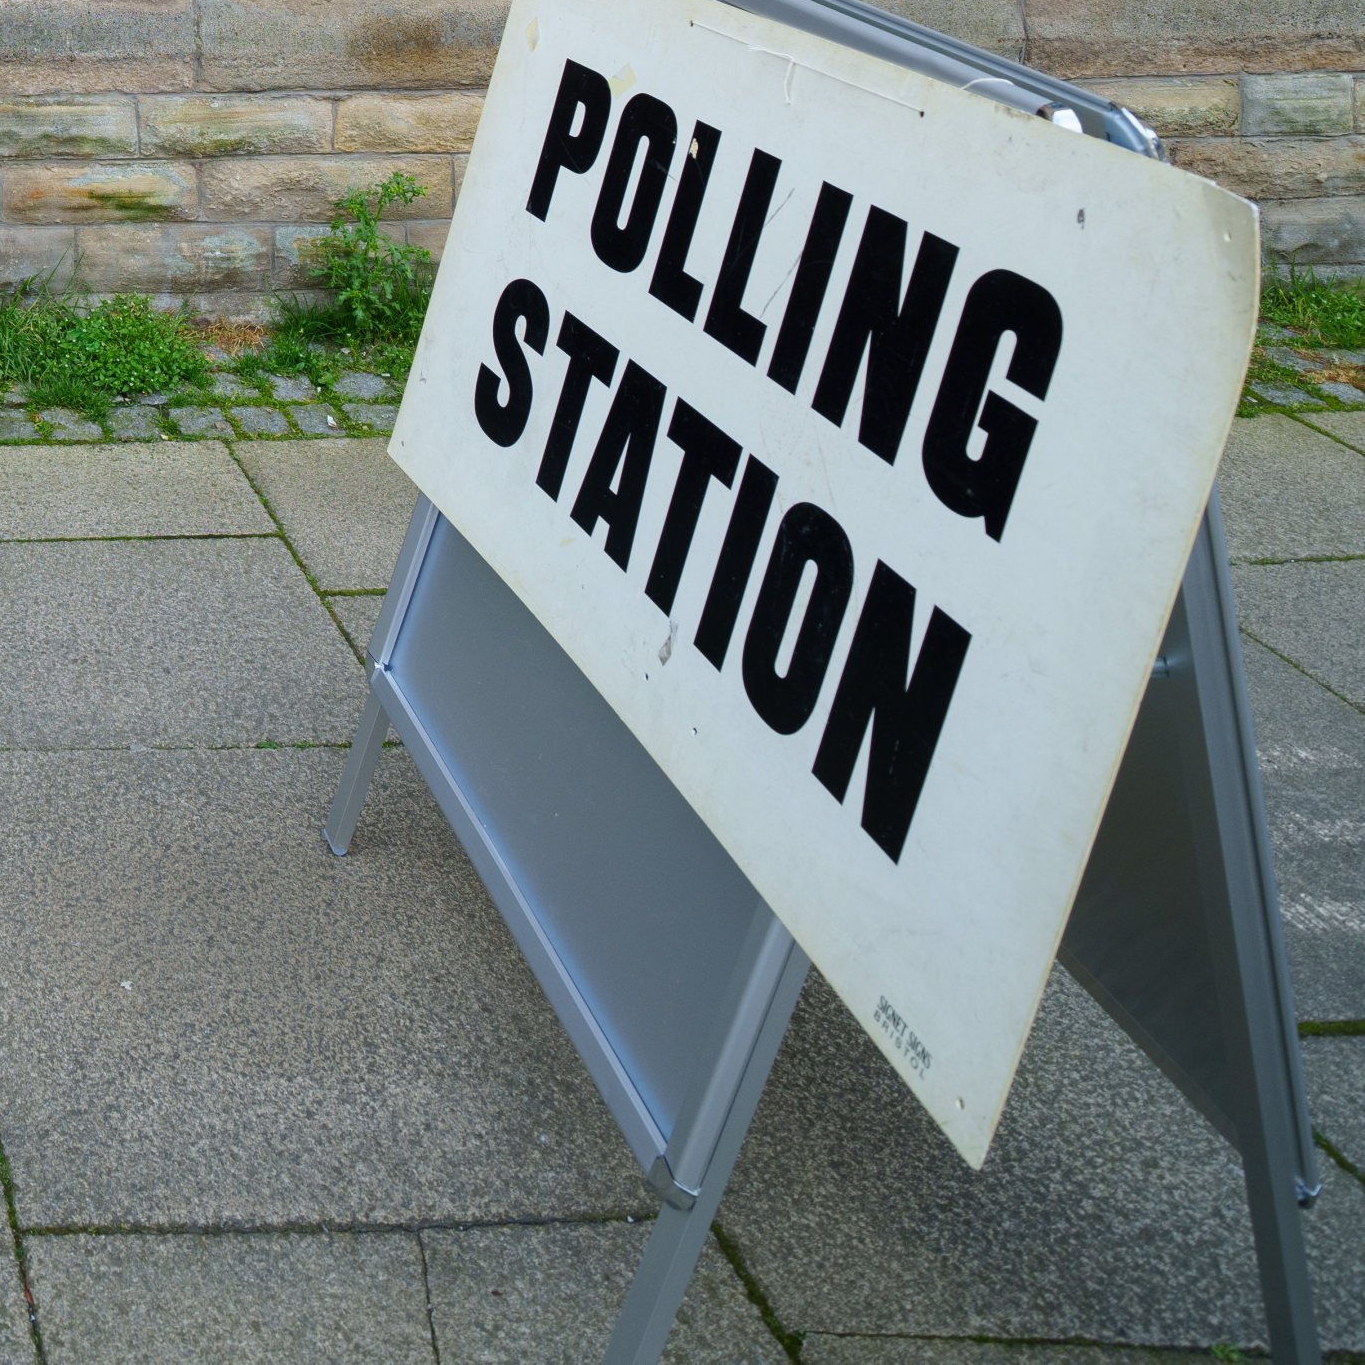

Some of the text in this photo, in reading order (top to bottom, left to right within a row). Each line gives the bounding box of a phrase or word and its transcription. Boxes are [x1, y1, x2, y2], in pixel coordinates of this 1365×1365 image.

[525, 58, 1065, 543] POLLING
[474, 278, 973, 866] STATION
[877, 995, 933, 1070] SIGNET SIGNS
